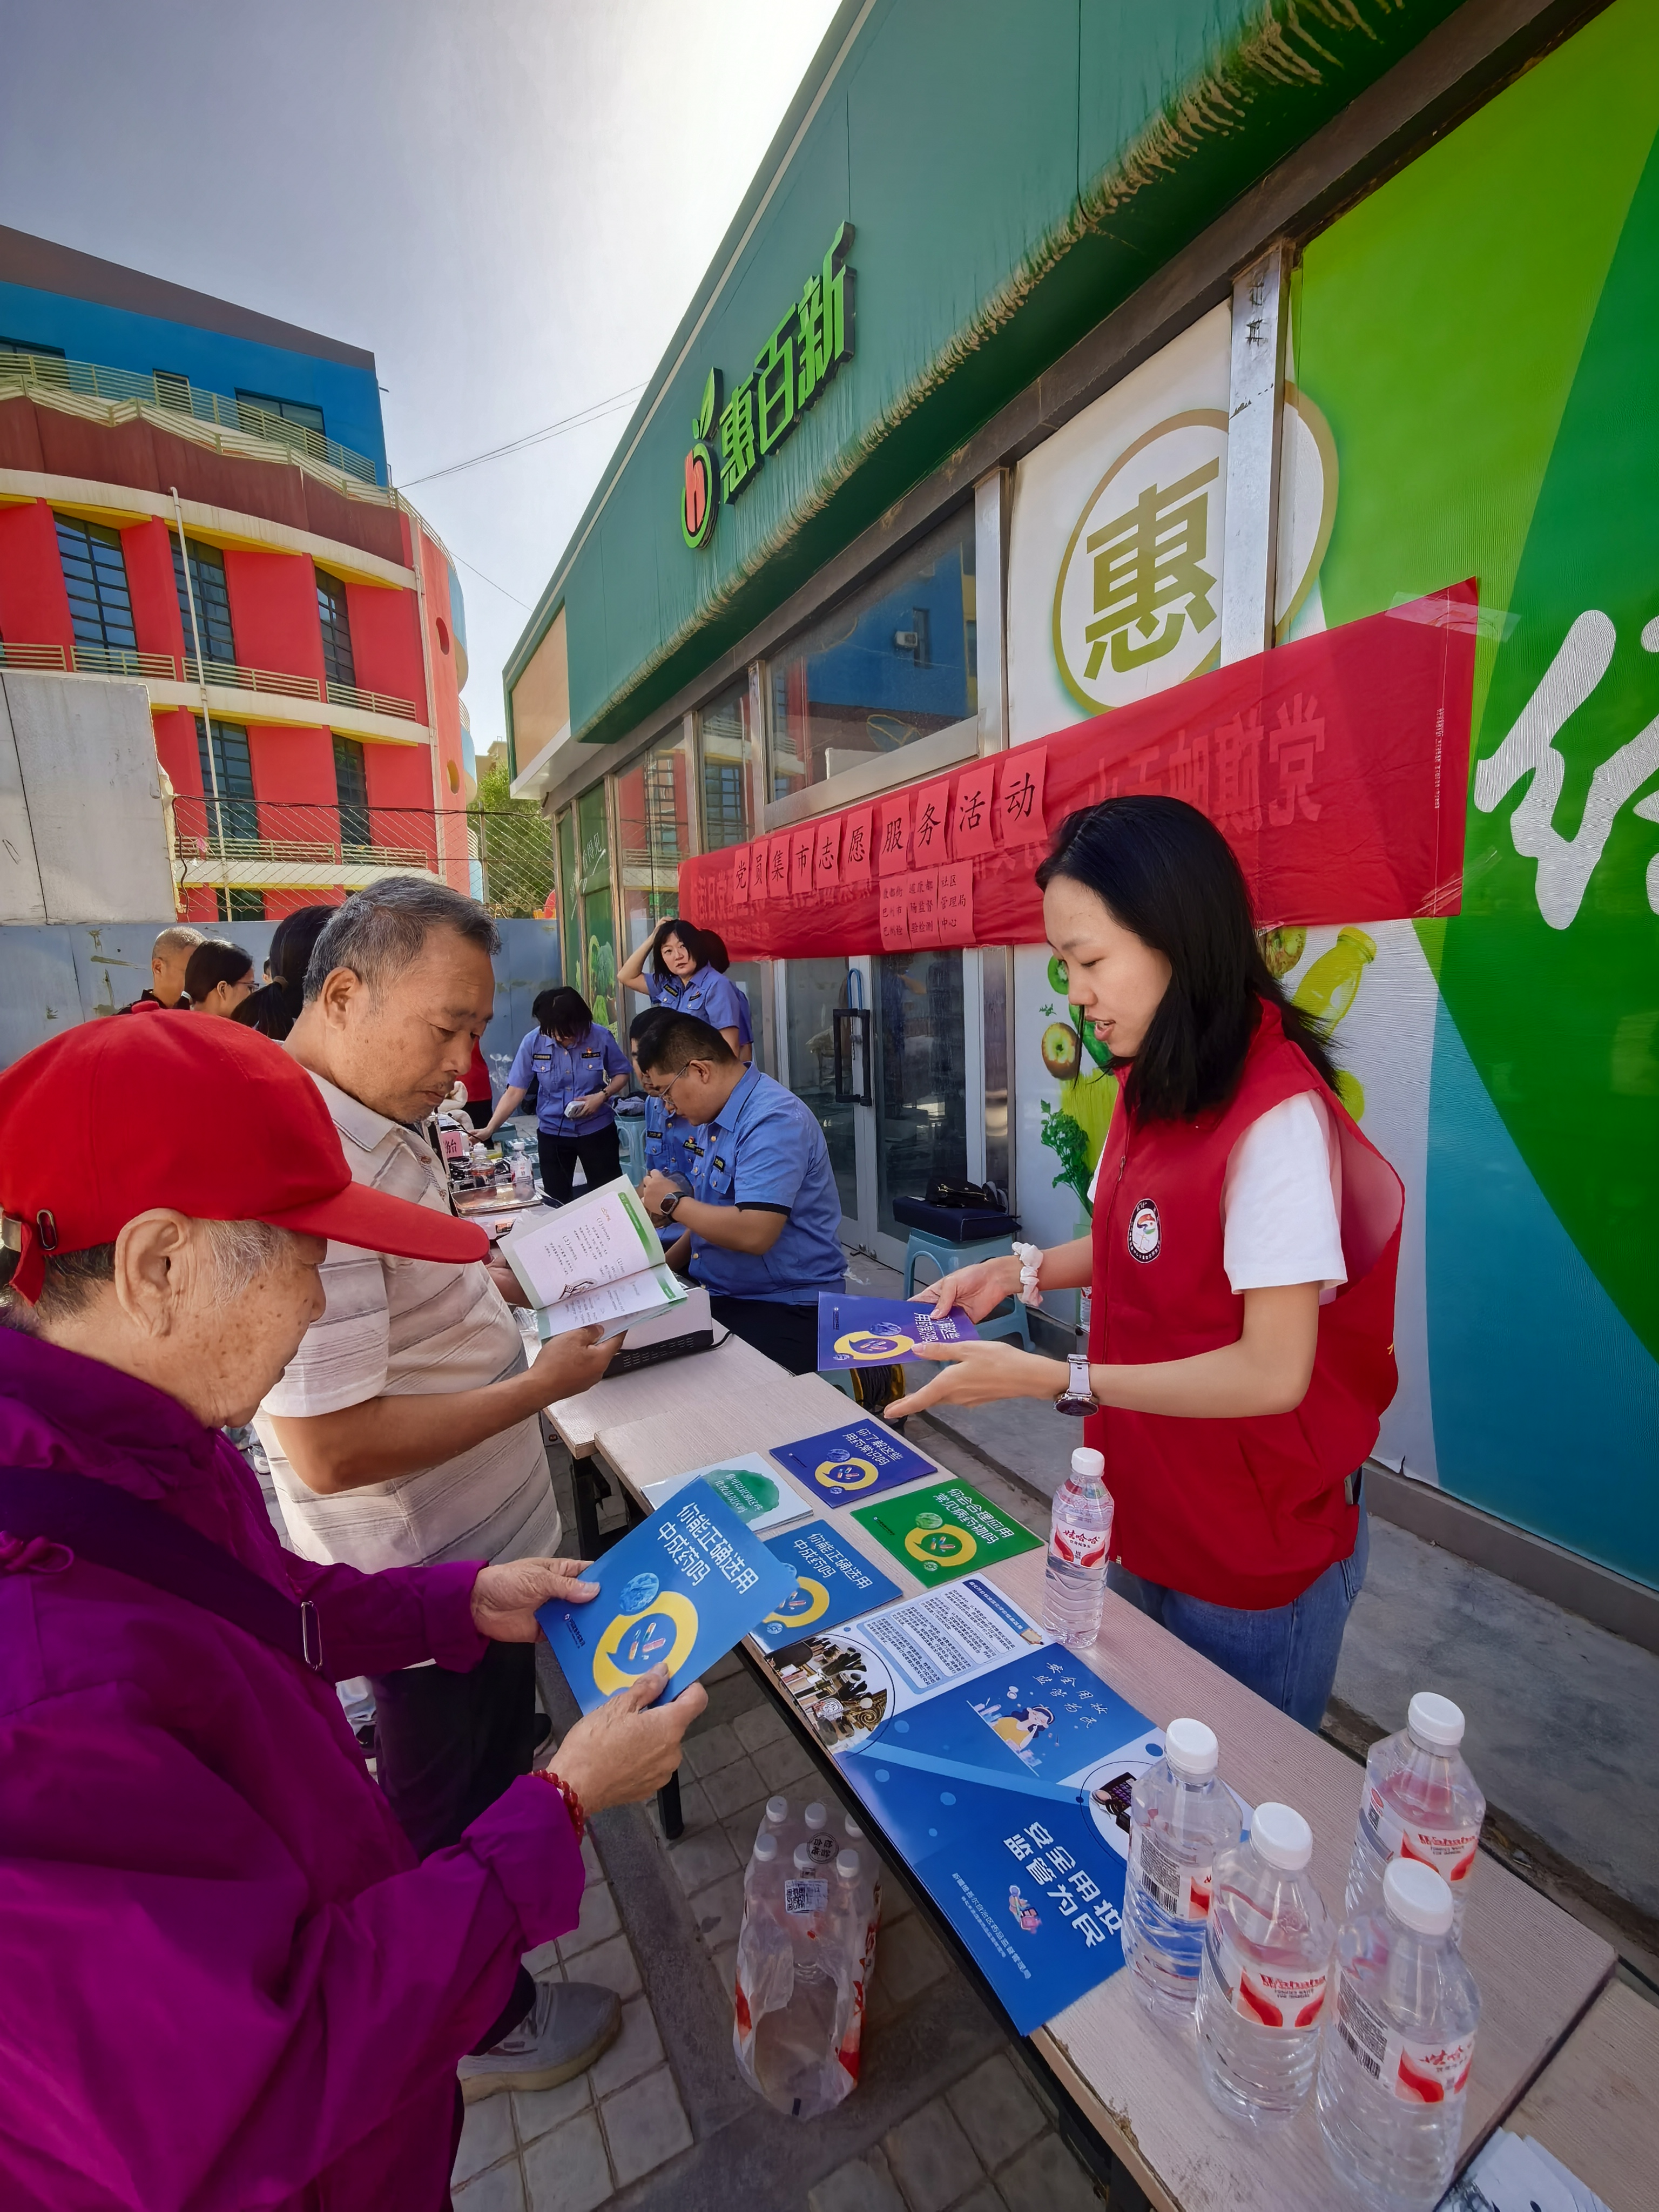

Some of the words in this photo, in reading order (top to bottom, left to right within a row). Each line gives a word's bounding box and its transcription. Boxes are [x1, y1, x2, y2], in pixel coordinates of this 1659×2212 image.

[720, 220, 855, 504] 惠百新
[1083, 456, 1219, 680] 惠
[734, 772, 1036, 891] 党员集市志愿服务活动
[936, 1316, 961, 1340] 了解这些
[842, 1433, 890, 1466] 用药常识吗
[856, 1428, 903, 1462] 你了解这些
[933, 1493, 999, 1545] 常见病药物吗
[947, 1488, 1015, 1539] 你会合理应用
[657, 1521, 712, 1587] 中成药吗
[676, 1501, 759, 1595] 你能正确选用
[792, 1539, 837, 1579] 中成药吗
[807, 1533, 873, 1590] 你能正确选用
[1003, 1834, 1105, 1948] 监管为民
